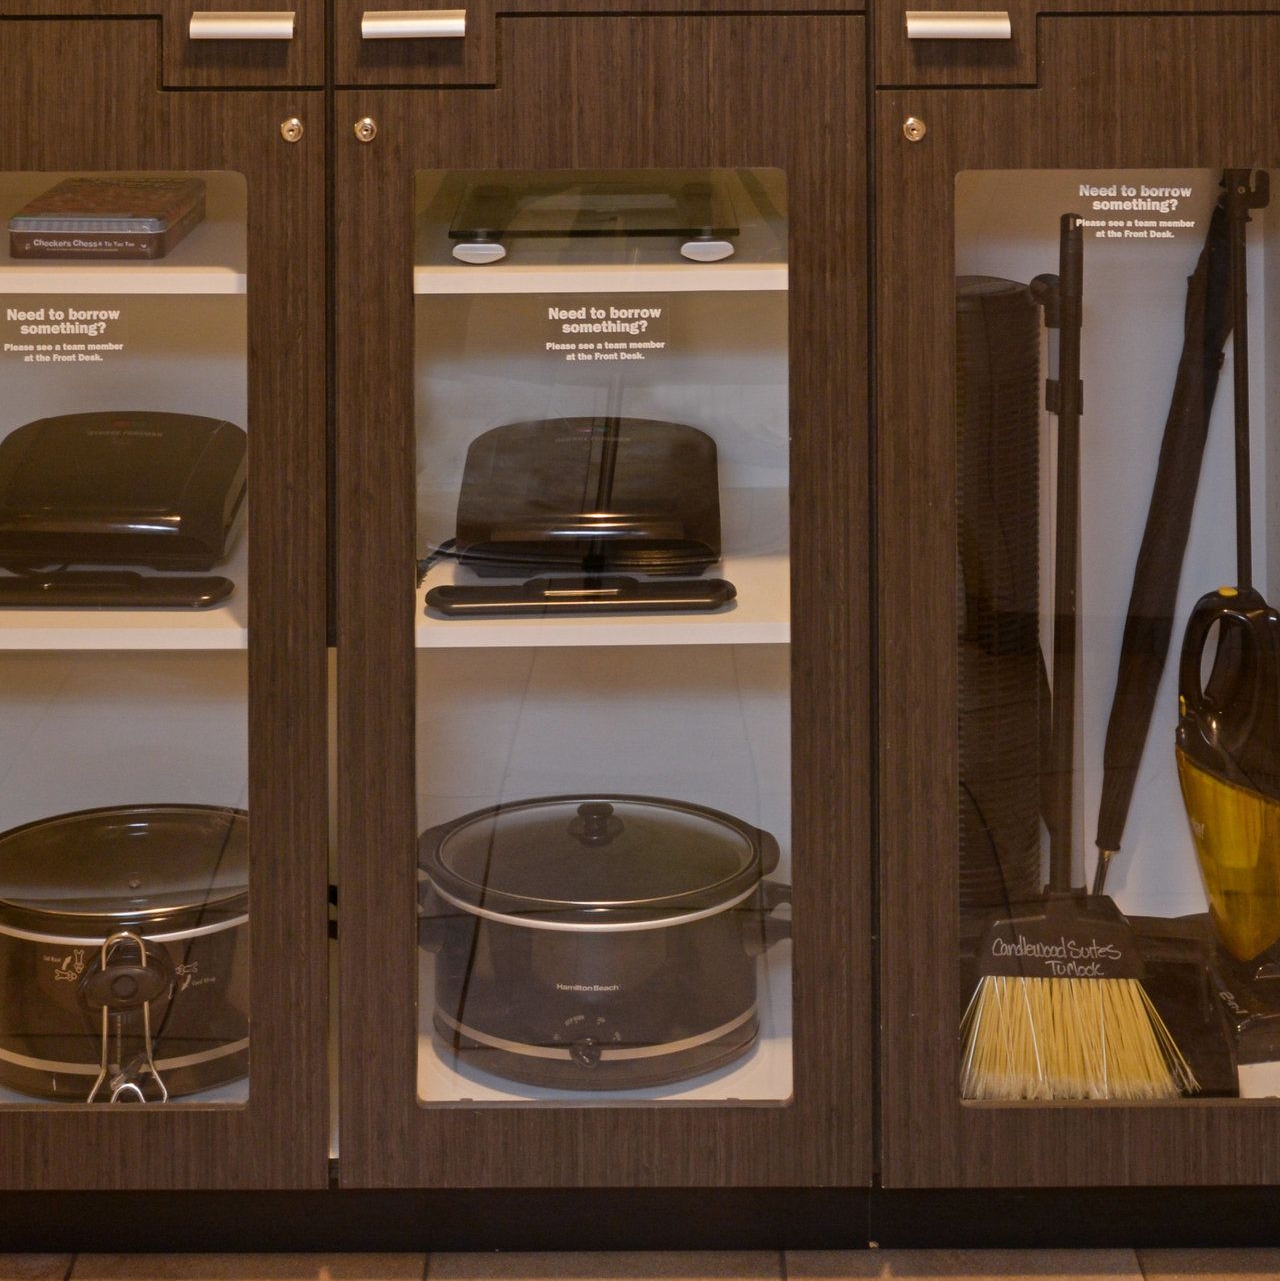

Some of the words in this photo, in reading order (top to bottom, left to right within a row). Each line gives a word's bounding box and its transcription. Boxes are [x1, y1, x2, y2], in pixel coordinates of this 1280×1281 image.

[1080, 185, 1117, 197] Need
[1121, 185, 1136, 196] to
[1141, 185, 1192, 197] borrow
[1093, 199, 1178, 213] something?
[1076, 219, 1106, 227] Please
[33, 239, 71, 247] Checkers
[73, 239, 97, 247] Chess
[7, 309, 44, 320] Need
[49, 309, 64, 320] to
[69, 309, 120, 320] borrow
[549, 307, 586, 319] Need
[590, 308, 606, 319] to
[610, 307, 661, 318] borrow
[20, 322, 106, 336] something?
[562, 320, 648, 334] something?
[620, 352, 645, 360] Desk.
[992, 935, 1067, 958] Candlewood
[1068, 939, 1121, 959] Suites
